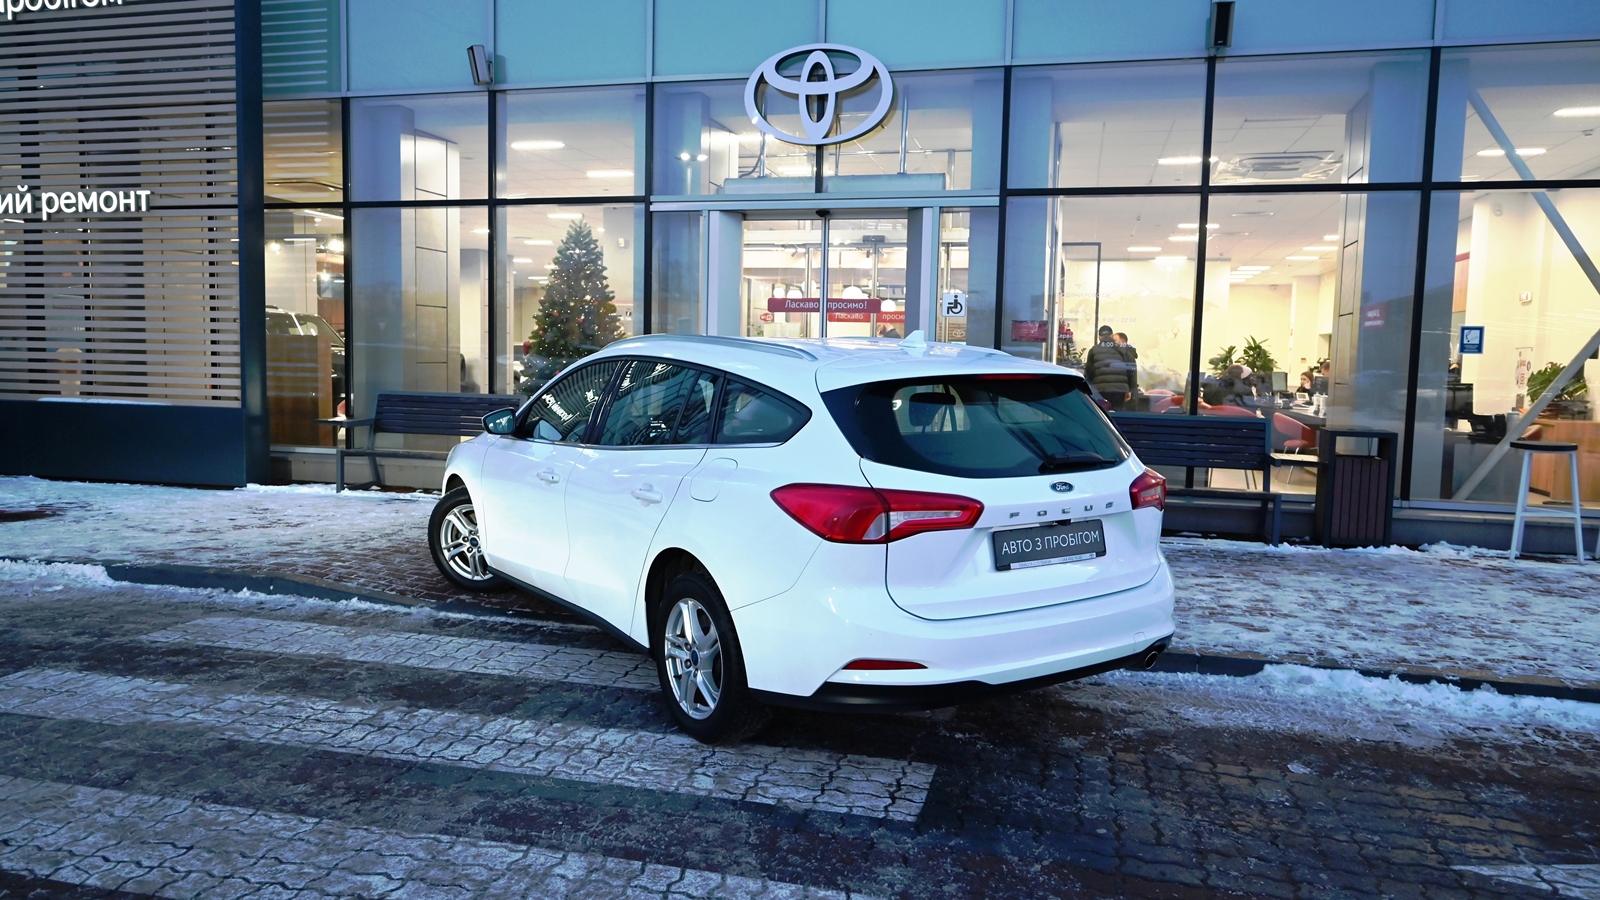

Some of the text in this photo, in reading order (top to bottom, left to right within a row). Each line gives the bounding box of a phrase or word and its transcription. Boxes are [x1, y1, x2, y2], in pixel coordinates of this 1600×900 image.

[41, 190, 151, 221] ремонт
[785, 299, 868, 311] Ласкаво просимо!
[1009, 501, 1114, 518] FOCUS
[1002, 539, 1033, 555] АВТО
[1044, 530, 1100, 549] ПРОБІГОМ
